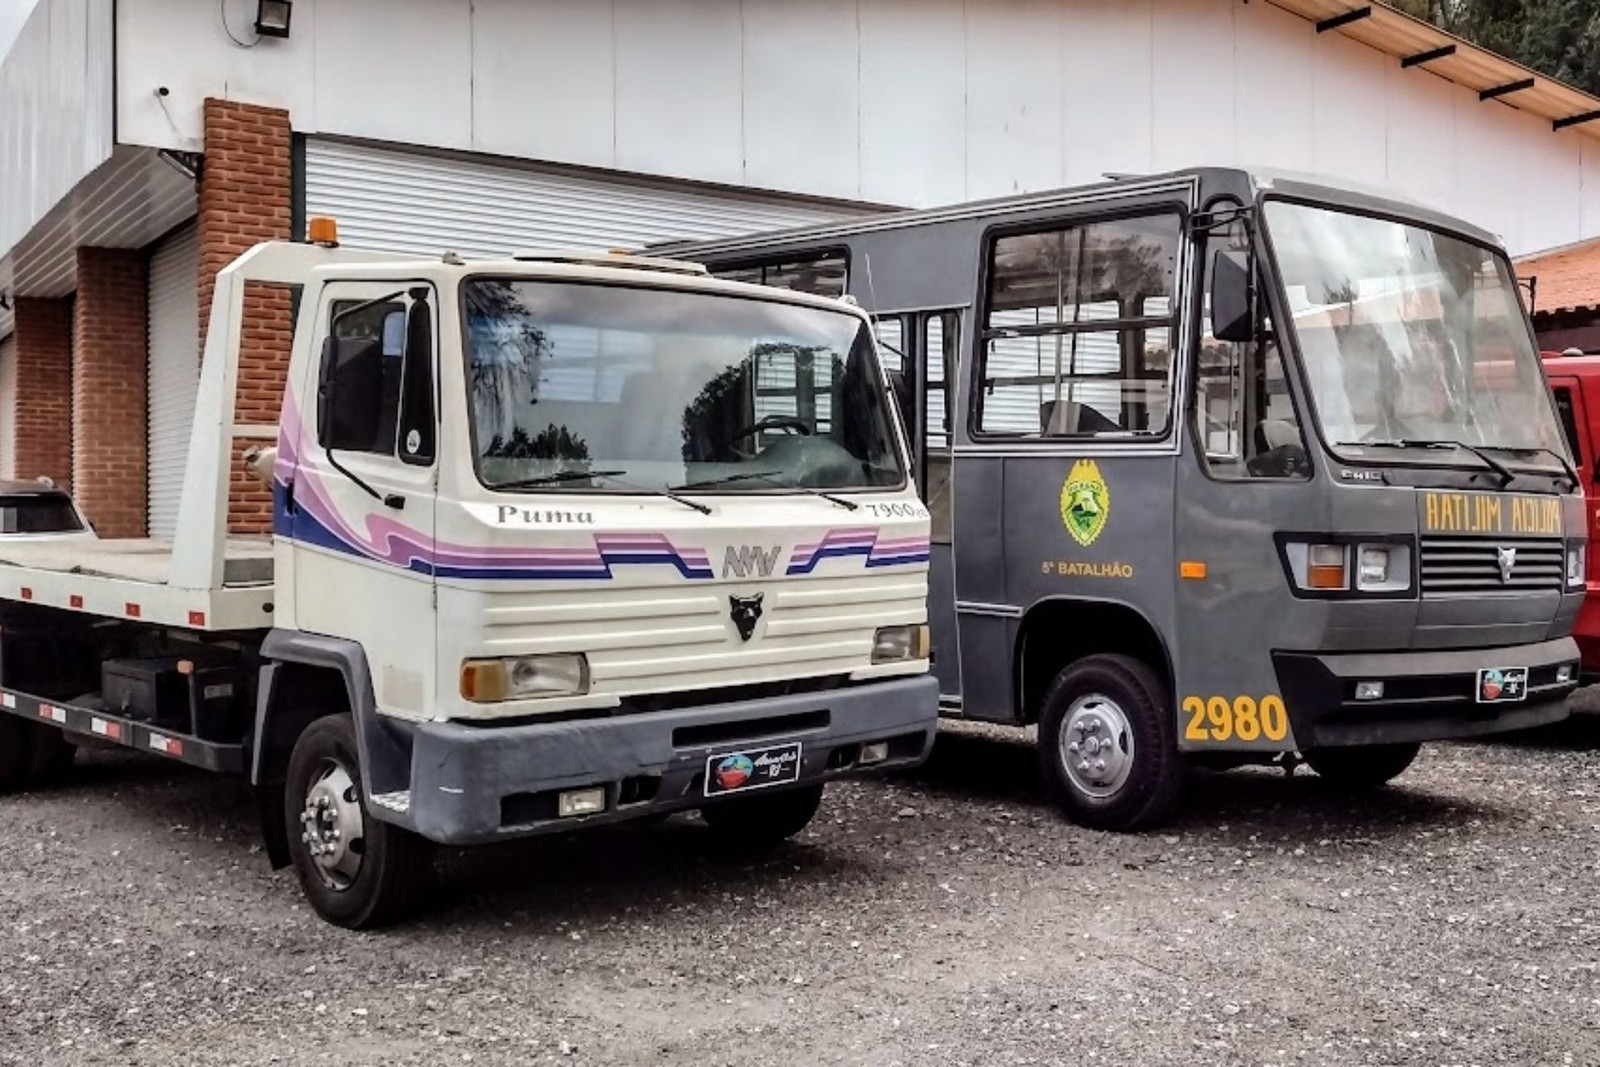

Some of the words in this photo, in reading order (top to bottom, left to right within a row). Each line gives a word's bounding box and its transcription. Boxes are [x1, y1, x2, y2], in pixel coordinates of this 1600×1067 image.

[496, 504, 594, 524] Puma
[866, 502, 915, 518] 7900
[1058, 561, 1134, 578] BATALHÃO
[1182, 694, 1288, 741] 2980
